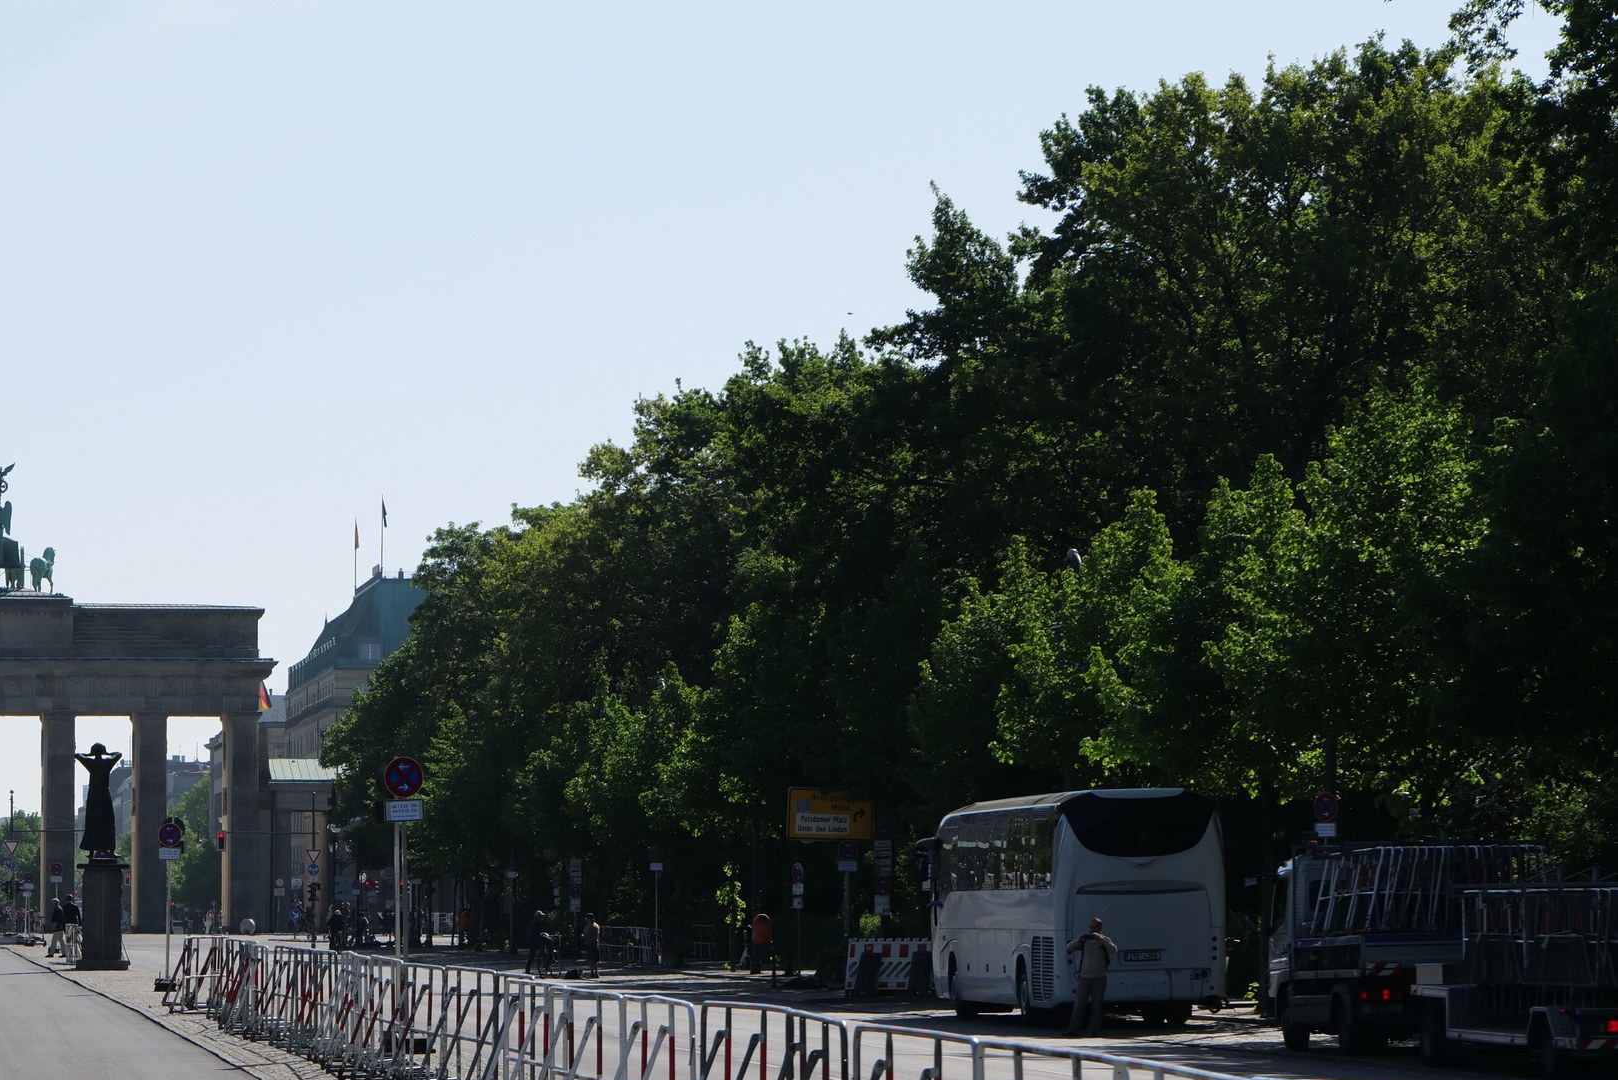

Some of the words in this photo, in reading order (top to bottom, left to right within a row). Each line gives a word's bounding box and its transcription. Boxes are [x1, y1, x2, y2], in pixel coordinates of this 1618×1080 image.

[800, 815, 831, 823] Potsdamer
[833, 816, 848, 824] Platz
[828, 825, 848, 833] Linden
